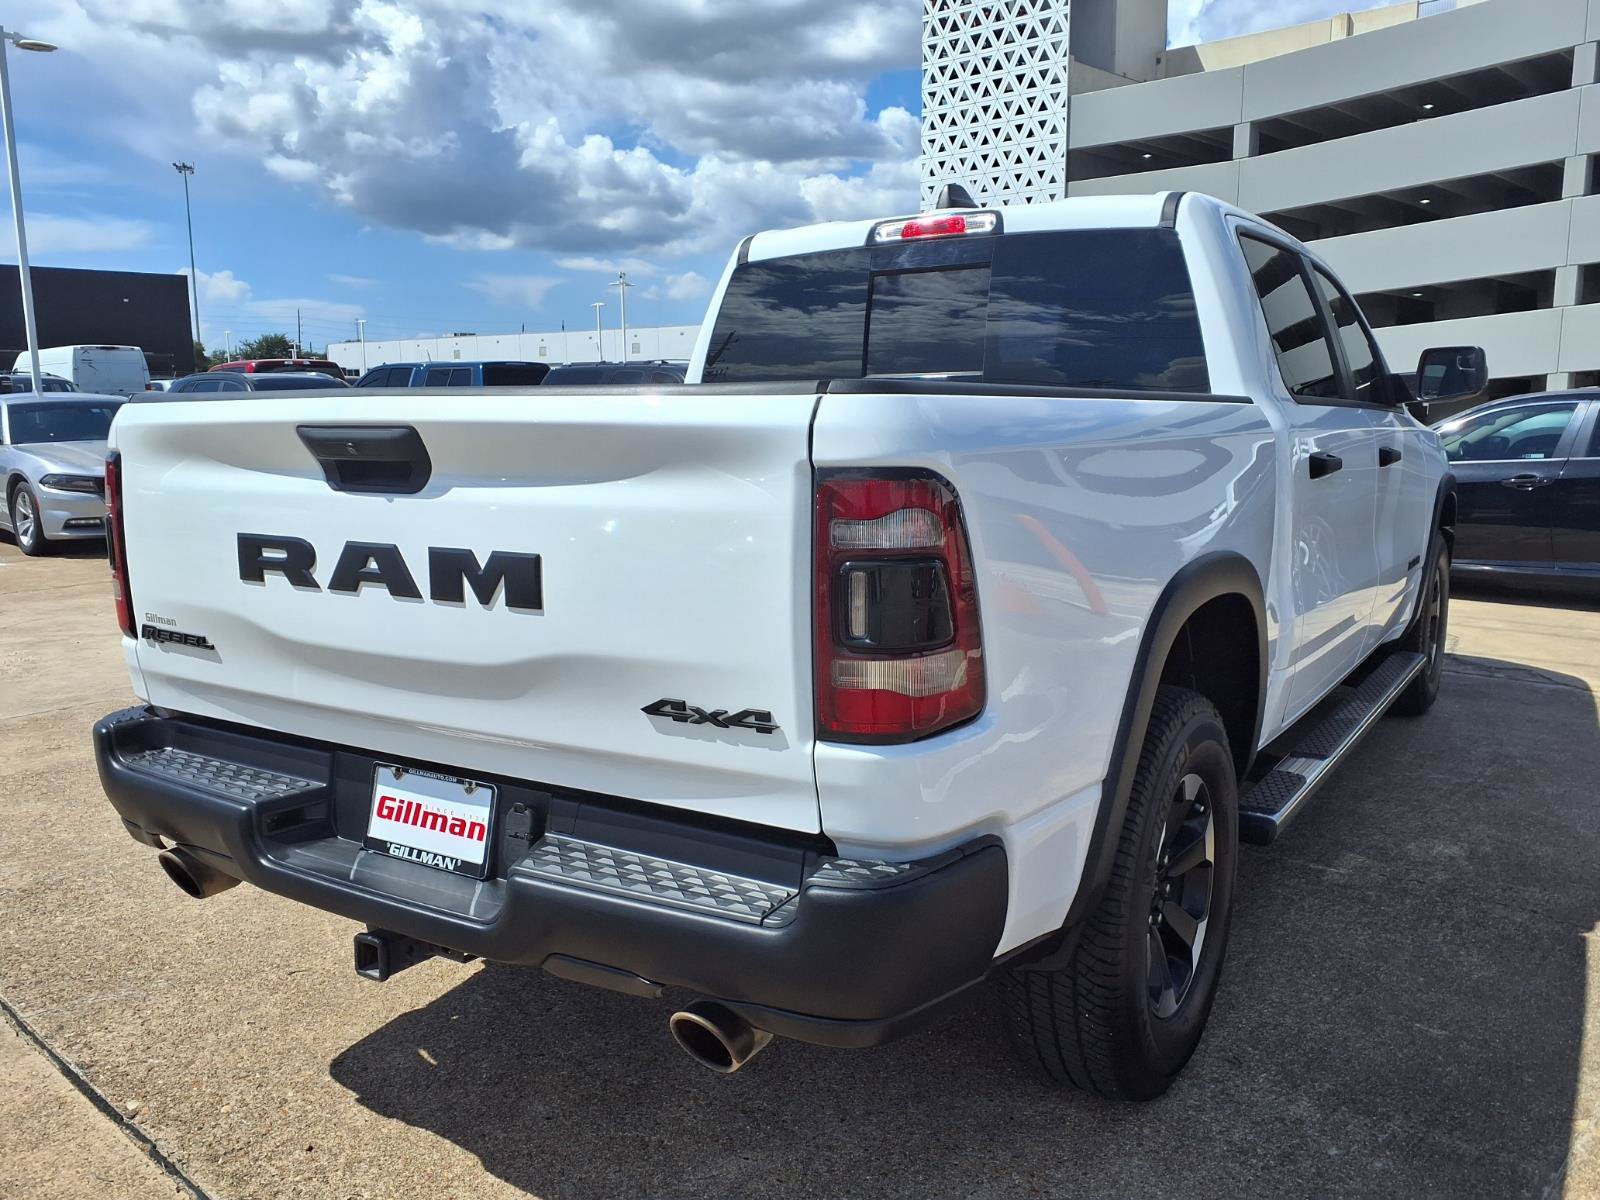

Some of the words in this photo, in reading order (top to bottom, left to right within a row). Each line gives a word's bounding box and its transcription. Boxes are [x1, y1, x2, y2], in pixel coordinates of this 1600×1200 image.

[236, 532, 542, 610] RAM
[141, 623, 215, 650] REBEL
[145, 612, 177, 627] Gillman
[640, 697, 781, 734] 4x4
[376, 795, 486, 842] Gillman
